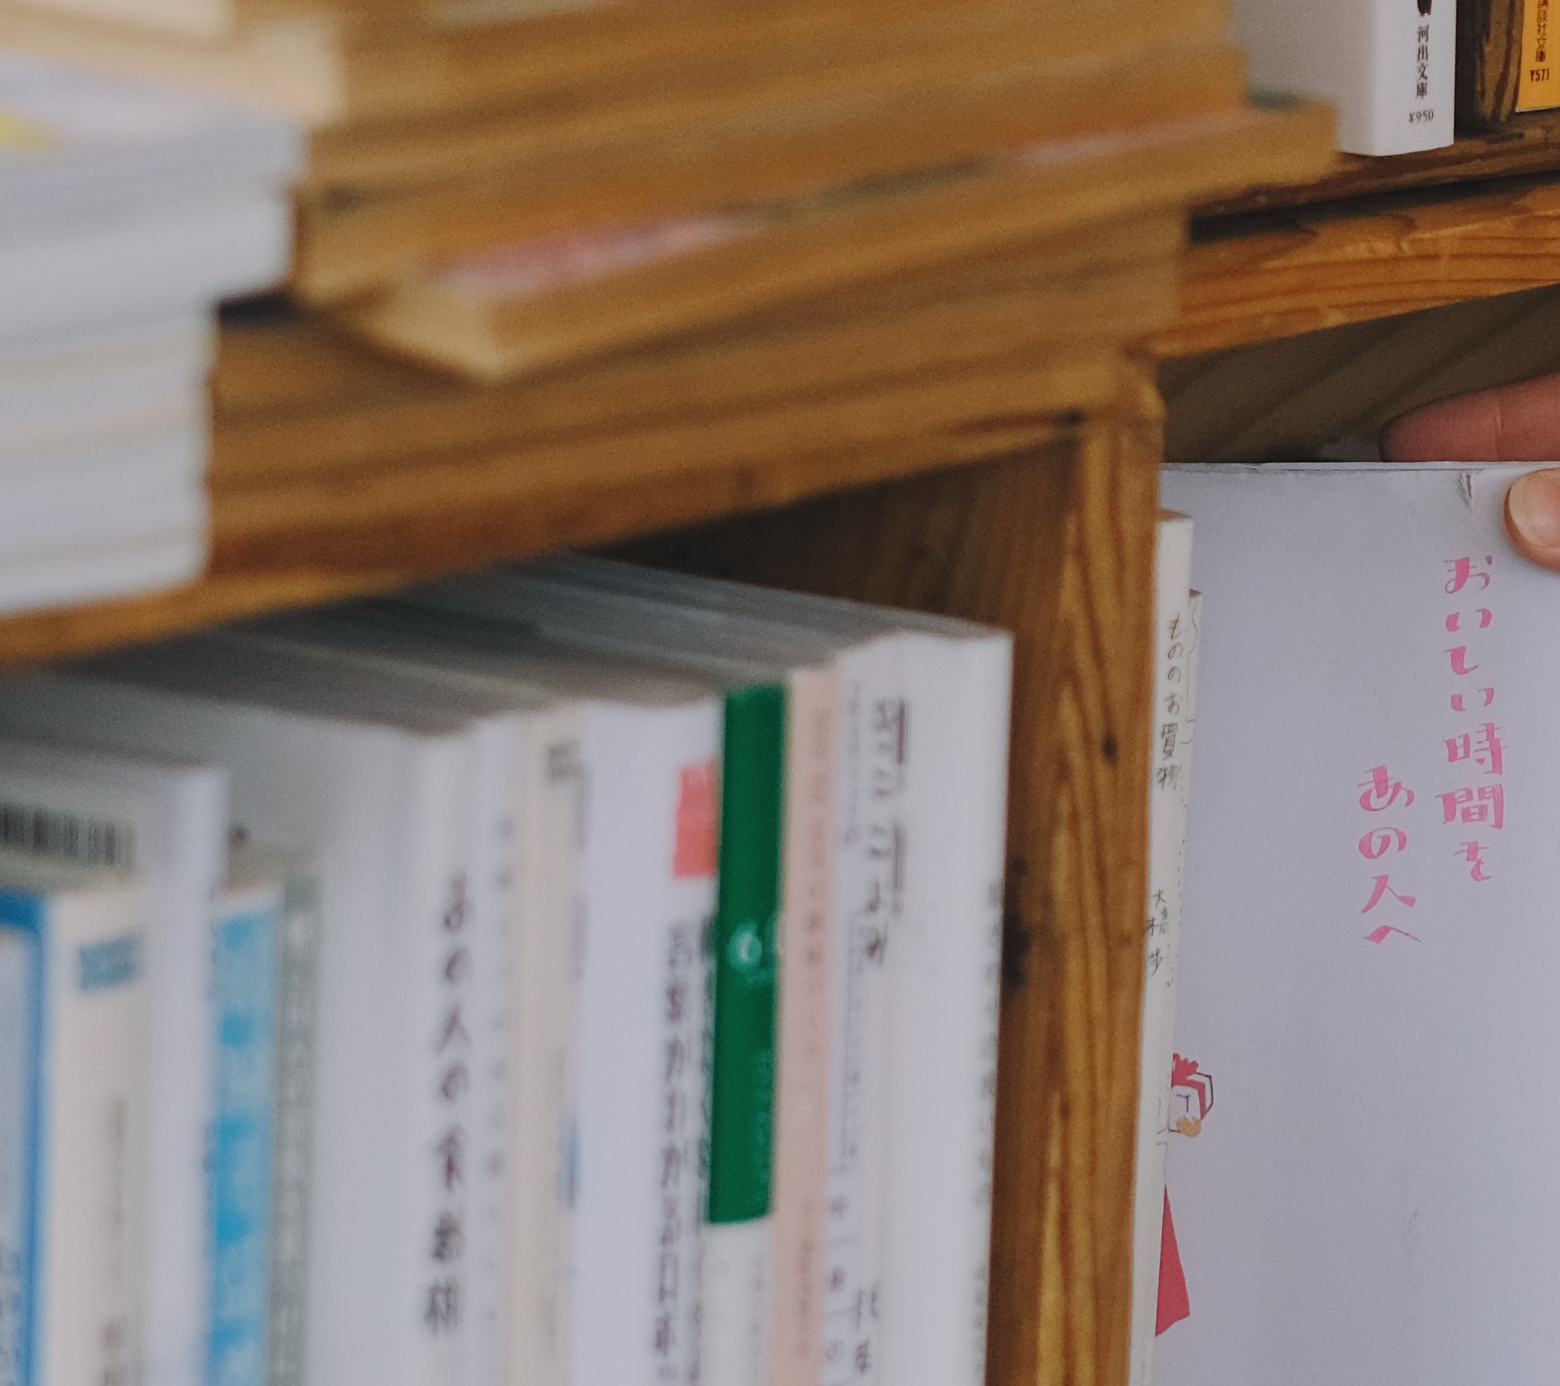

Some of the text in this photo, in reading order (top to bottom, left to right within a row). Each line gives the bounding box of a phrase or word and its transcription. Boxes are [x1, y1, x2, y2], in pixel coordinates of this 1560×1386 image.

[1408, 109, 1435, 124] ¥950
[1416, 24, 1430, 100] 河出文庫
[1440, 551, 1510, 883] おいしい時間を
[1355, 760, 1423, 949] あの人へ
